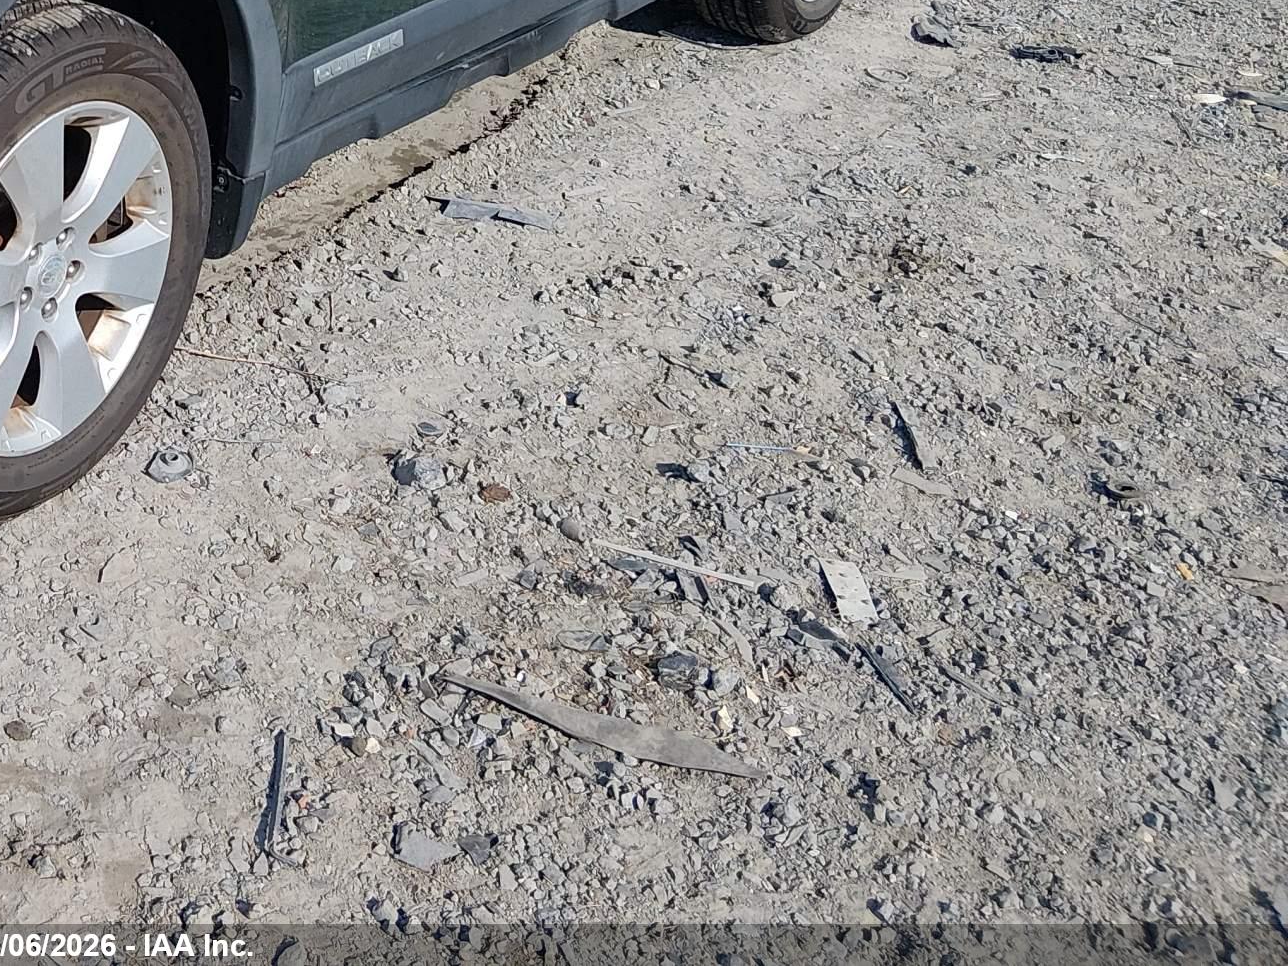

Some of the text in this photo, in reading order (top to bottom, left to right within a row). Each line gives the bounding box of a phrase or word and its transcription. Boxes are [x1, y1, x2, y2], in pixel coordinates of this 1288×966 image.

[15, 46, 107, 115] GT RADIAL
[315, 30, 403, 86] OUTBACK
